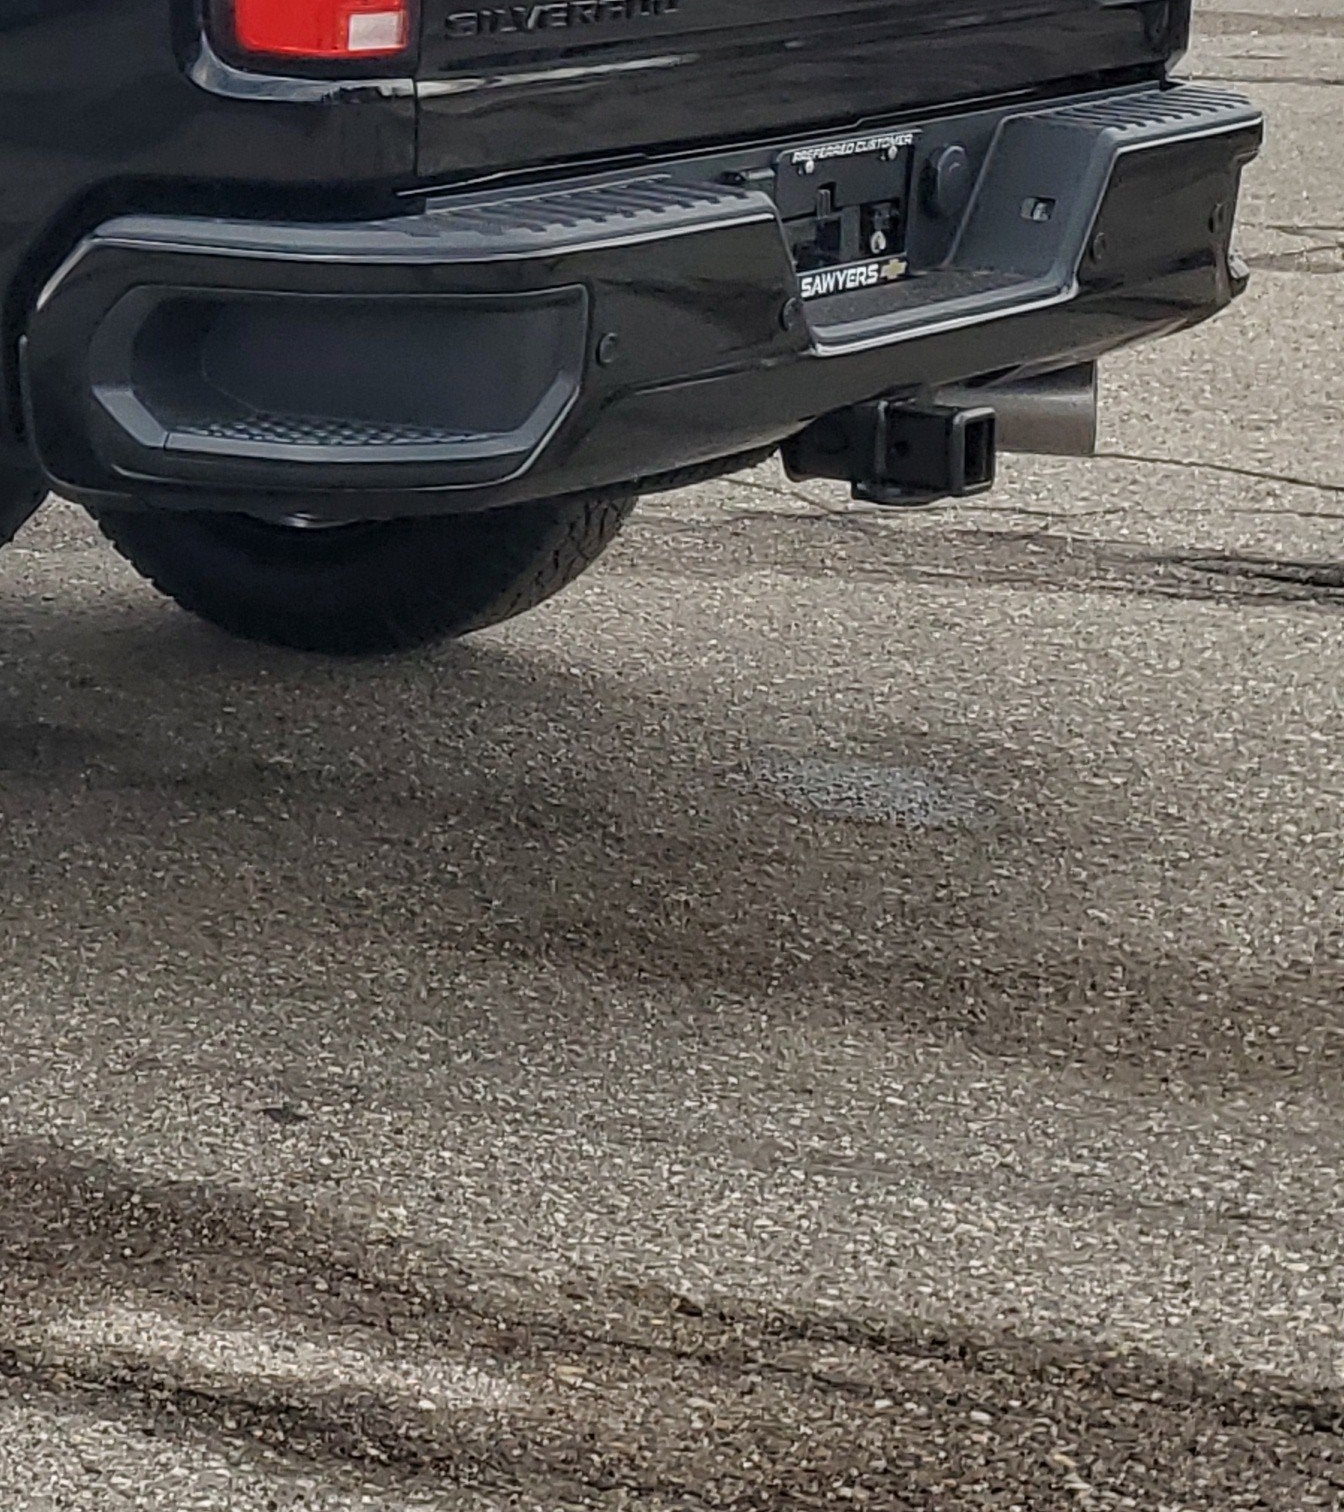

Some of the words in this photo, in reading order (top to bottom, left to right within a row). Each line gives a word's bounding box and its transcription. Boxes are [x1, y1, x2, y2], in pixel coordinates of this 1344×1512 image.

[792, 142, 855, 164] PREFERRED
[855, 133, 914, 153] CUSTOMER
[800, 263, 879, 299] SAWYERS
